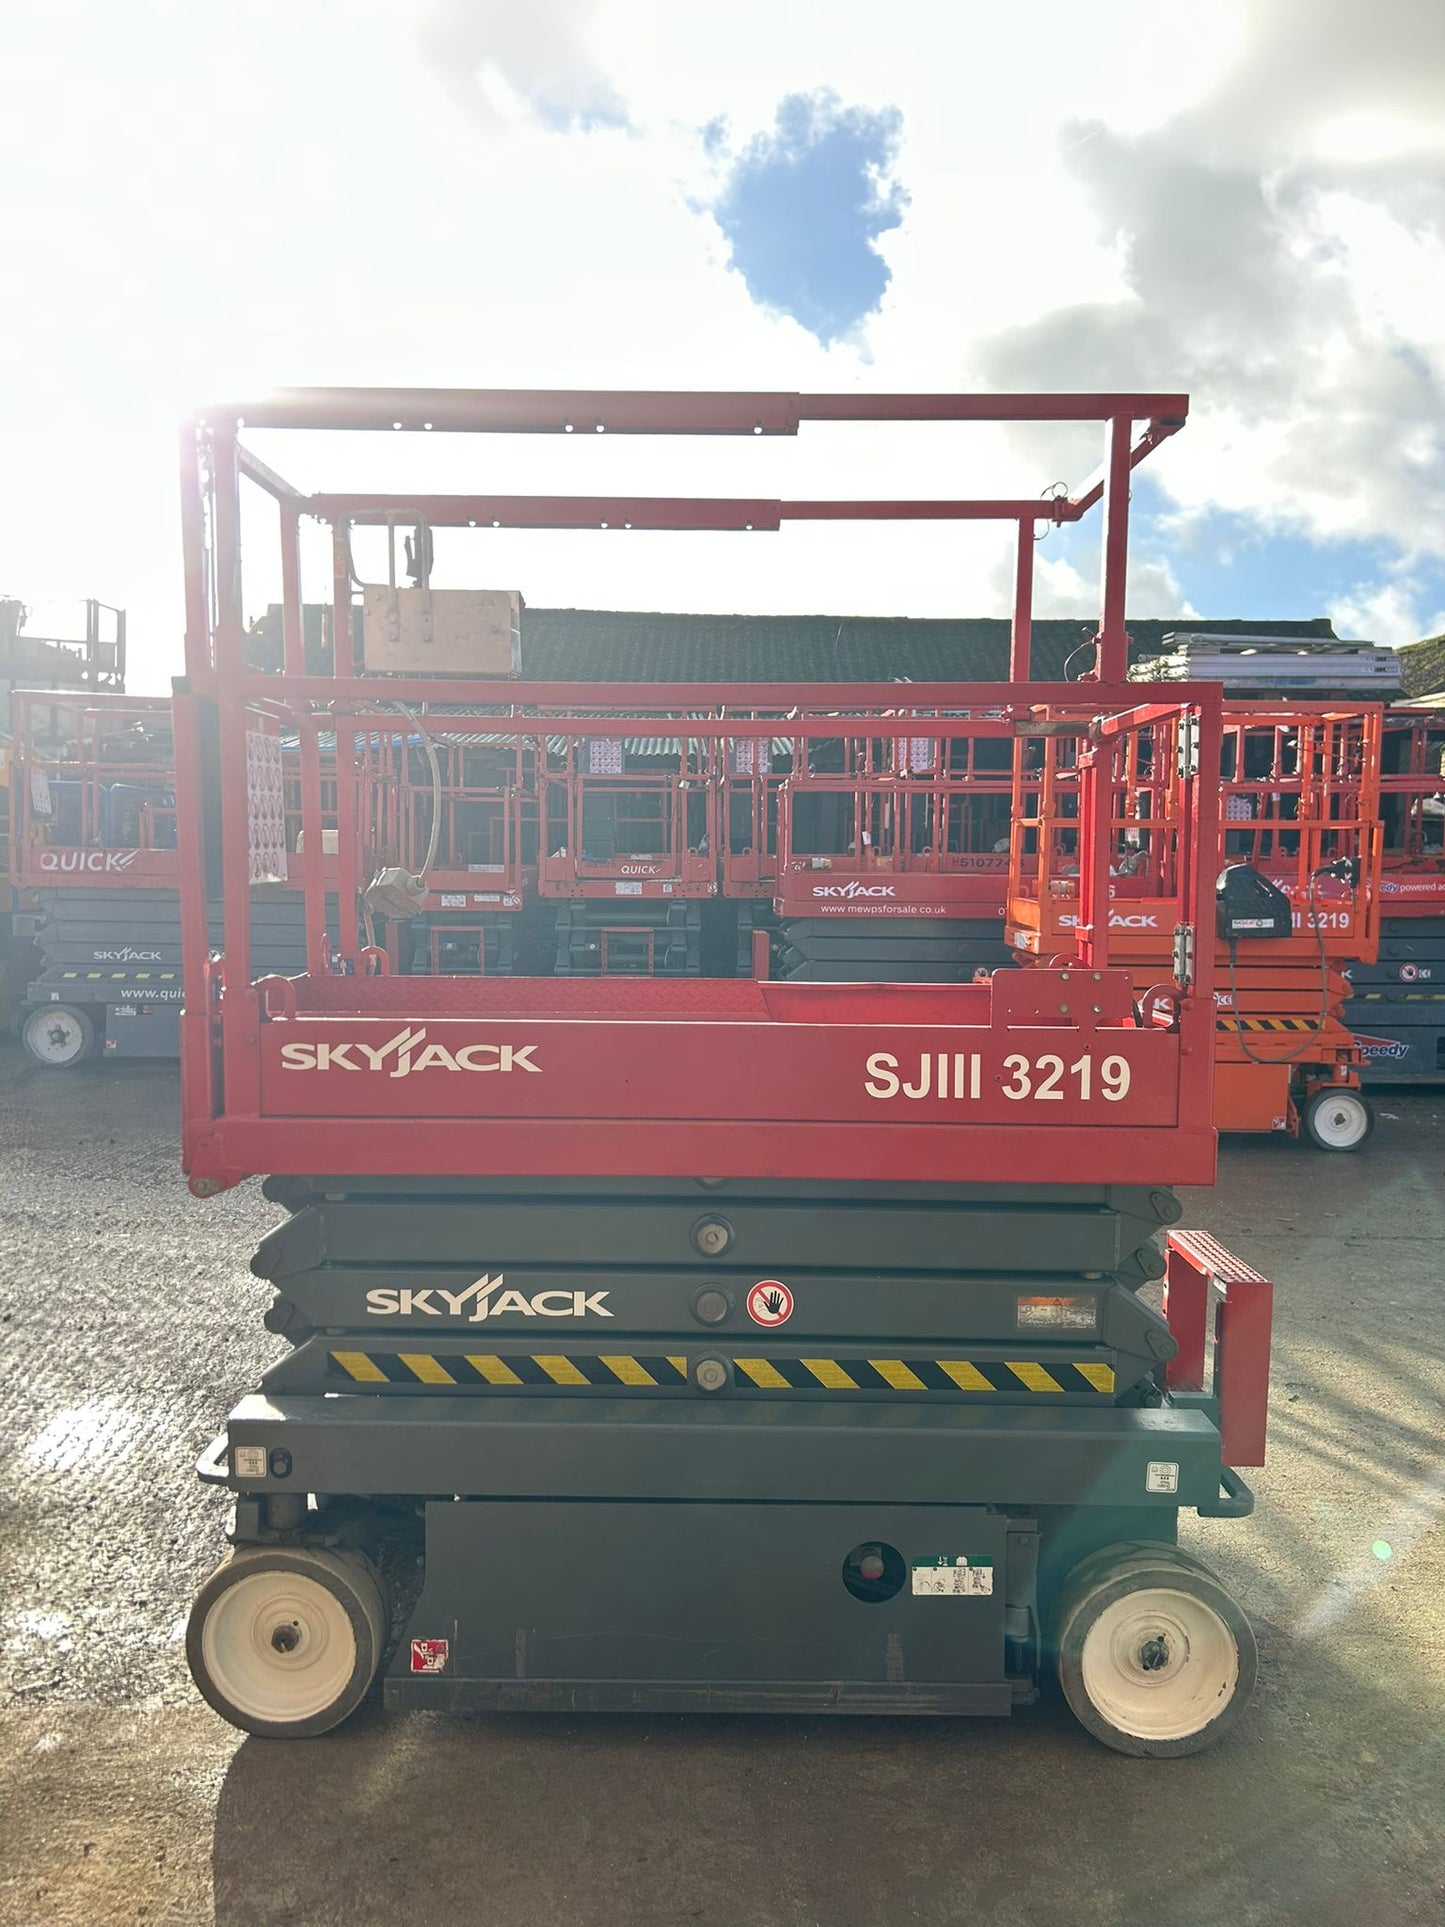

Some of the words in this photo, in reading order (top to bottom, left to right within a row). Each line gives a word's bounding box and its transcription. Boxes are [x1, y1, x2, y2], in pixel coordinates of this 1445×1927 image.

[40, 853, 123, 871] QUICK
[621, 865, 657, 874] QUICK
[812, 880, 896, 898] SKYJACK
[1400, 882, 1436, 893] powered
[1307, 912, 1349, 928] 3219
[93, 947, 162, 961] SKYJACK
[280, 1026, 543, 1078] SKYJACK
[864, 1052, 981, 1099] SJIII
[1001, 1054, 1131, 1101] 3219
[365, 1273, 615, 1322] SKYJACK
